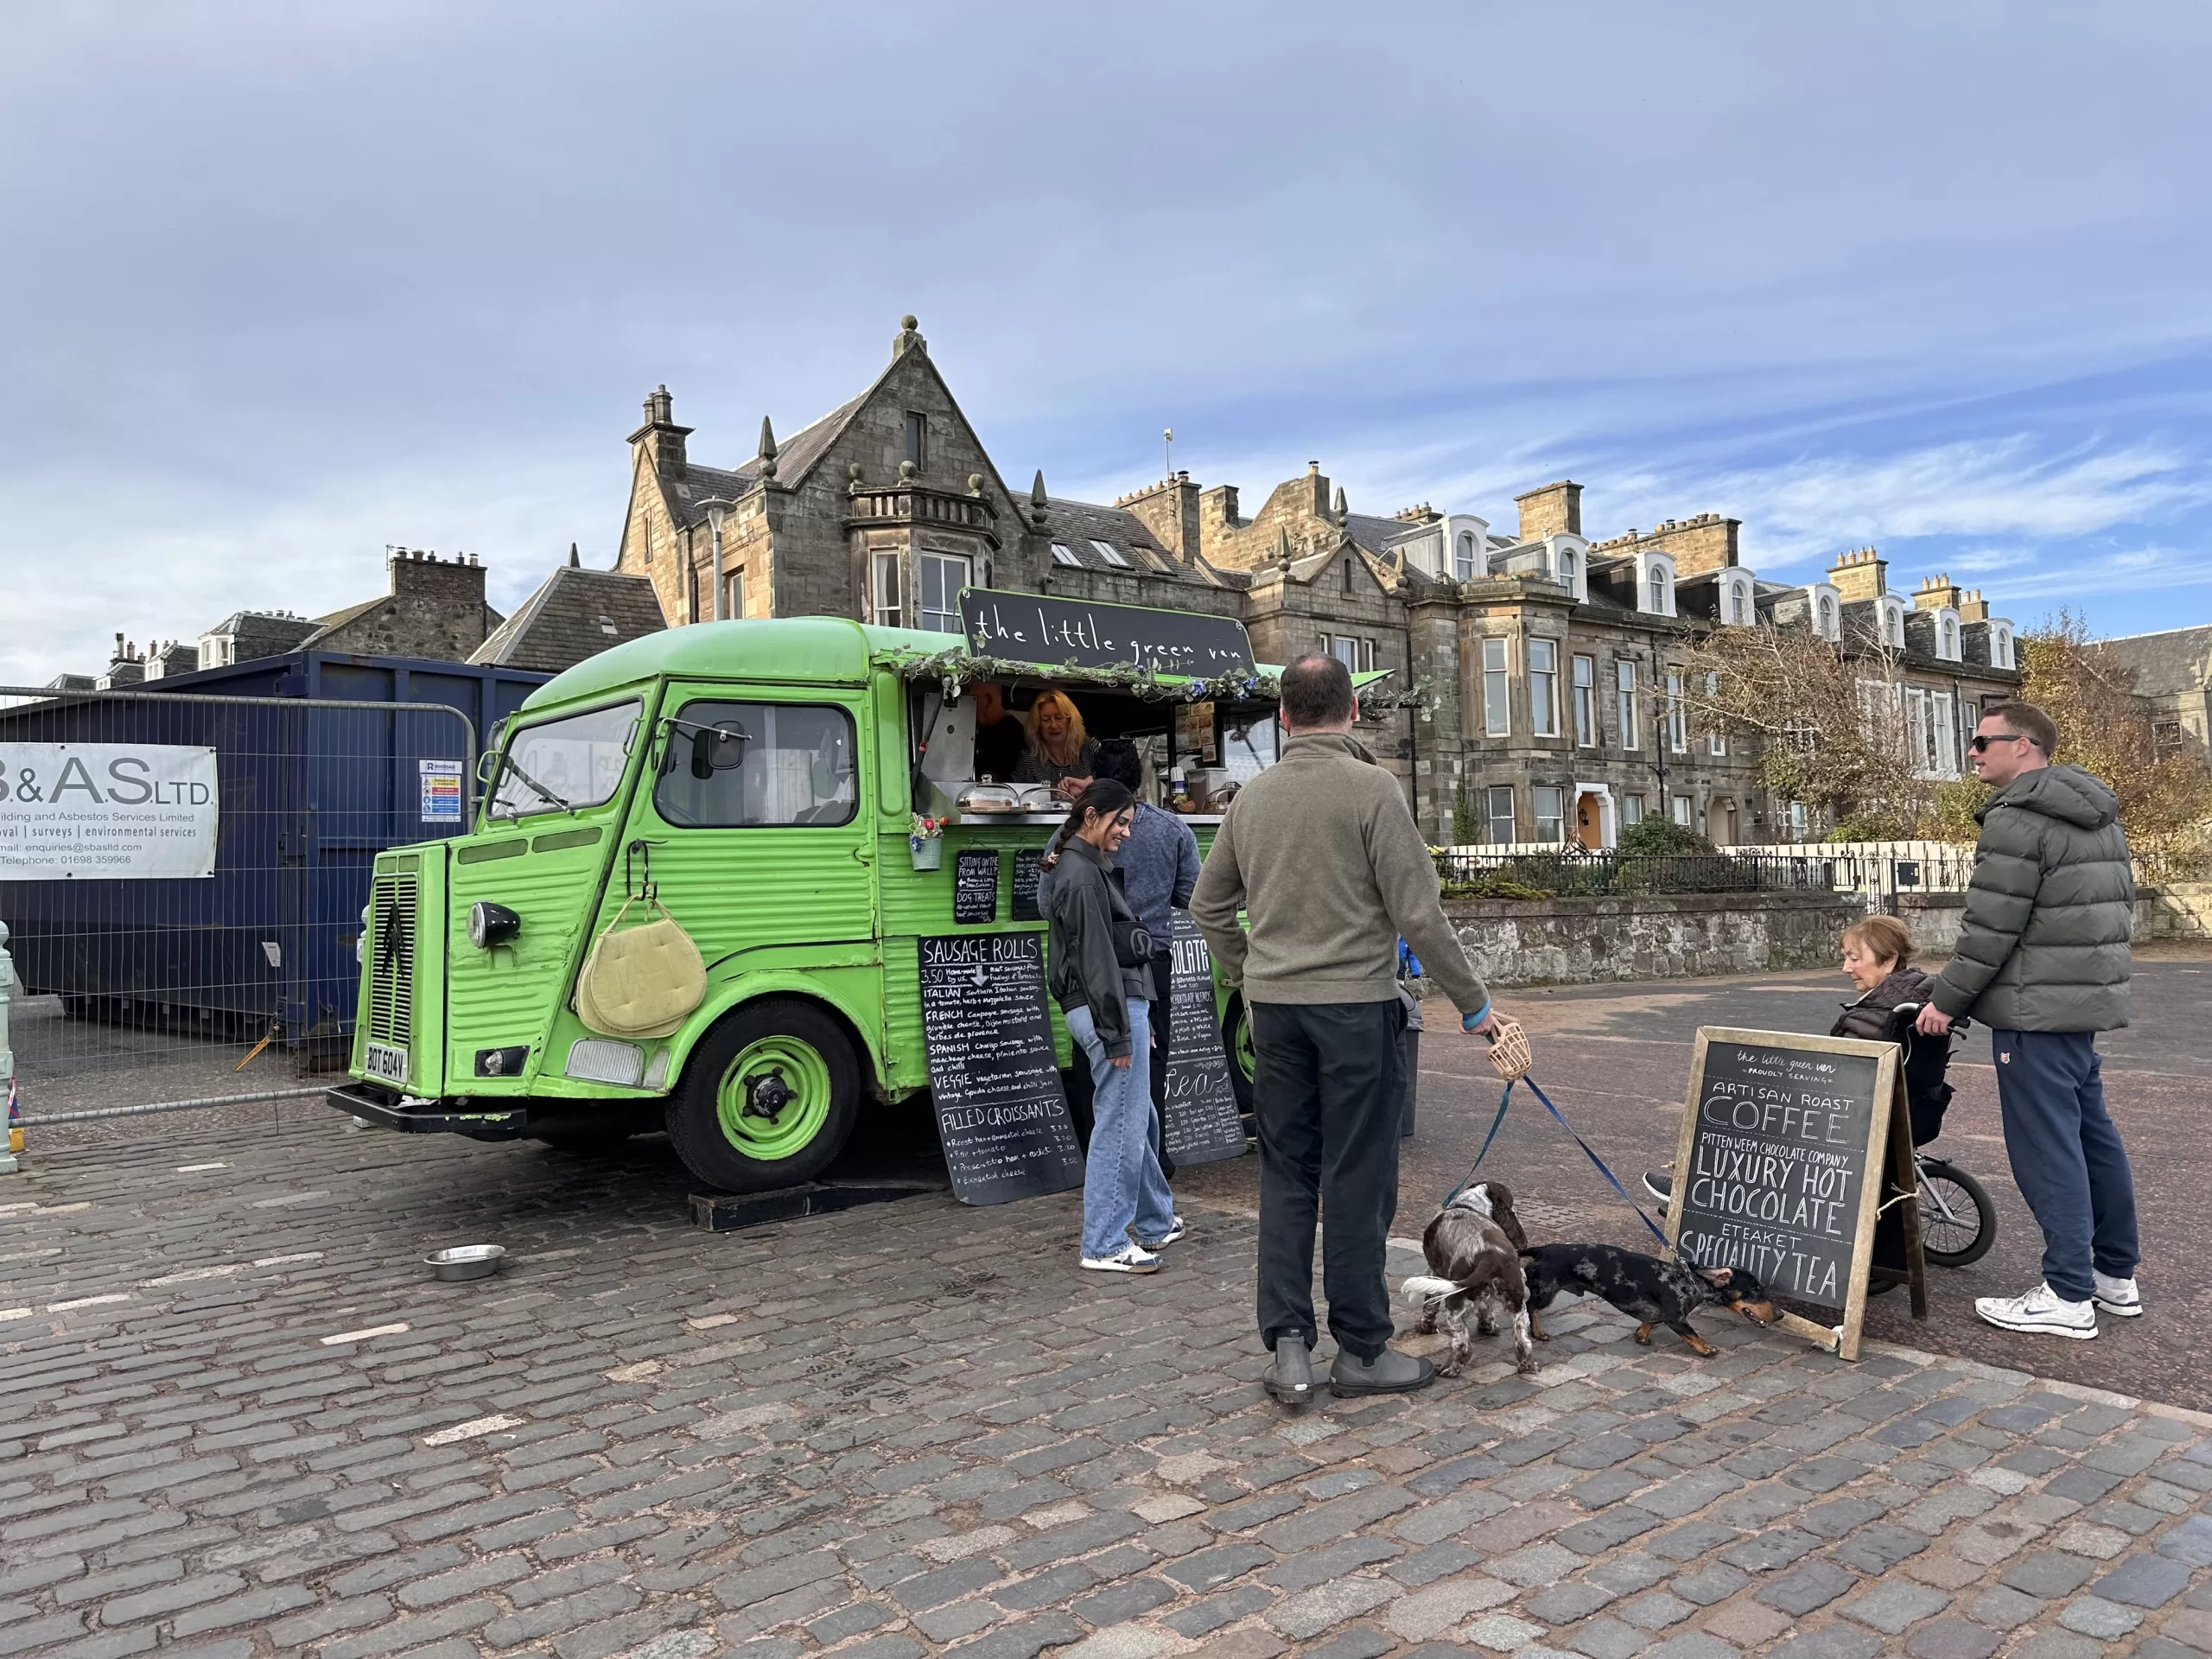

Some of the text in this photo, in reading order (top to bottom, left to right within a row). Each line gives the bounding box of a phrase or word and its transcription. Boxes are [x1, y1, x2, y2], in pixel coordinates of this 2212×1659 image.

[976, 604, 1241, 665] the little green van
[0, 811, 194, 823] ilding and Asbestos Services Limited
[0, 825, 197, 838] val surveys environmental services
[0, 842, 142, 854] mail: enquiries@sbasltd.com
[0, 855, 131, 866] Telephone: 01698 359966
[958, 856, 982, 868] SITTING
[958, 867, 998, 877] PROM WALL?
[957, 891, 995, 903] DOG TREATS
[924, 938, 1038, 963] SAUSAGE ROLLS
[921, 969, 944, 983] 3.50
[924, 988, 961, 998] ITALIAN
[925, 1009, 963, 1023] FRENCH
[967, 1028, 1000, 1040] provence
[930, 1042, 969, 1055] SPANISH
[367, 1046, 404, 1078] BOT 604V
[1737, 1050, 1758, 1063] the
[1761, 1053, 1787, 1066] little
[1785, 1059, 1815, 1072] green
[933, 1072, 973, 1090] VEGGIE
[1713, 1081, 1854, 1111] ARTISAN ROAST
[941, 1098, 1065, 1135] FILLED CROISSANTS
[1703, 1096, 1850, 1144] COFFEE
[1759, 1141, 1806, 1162] CHOCOLATE
[1808, 1150, 1849, 1169] COMPANY
[1696, 1144, 1853, 1202] LUXURY HOT
[1691, 1178, 1847, 1236] CHOCOLATE
[1721, 1223, 1802, 1250] ETEAKET
[1791, 1252, 1837, 1300] TEA
